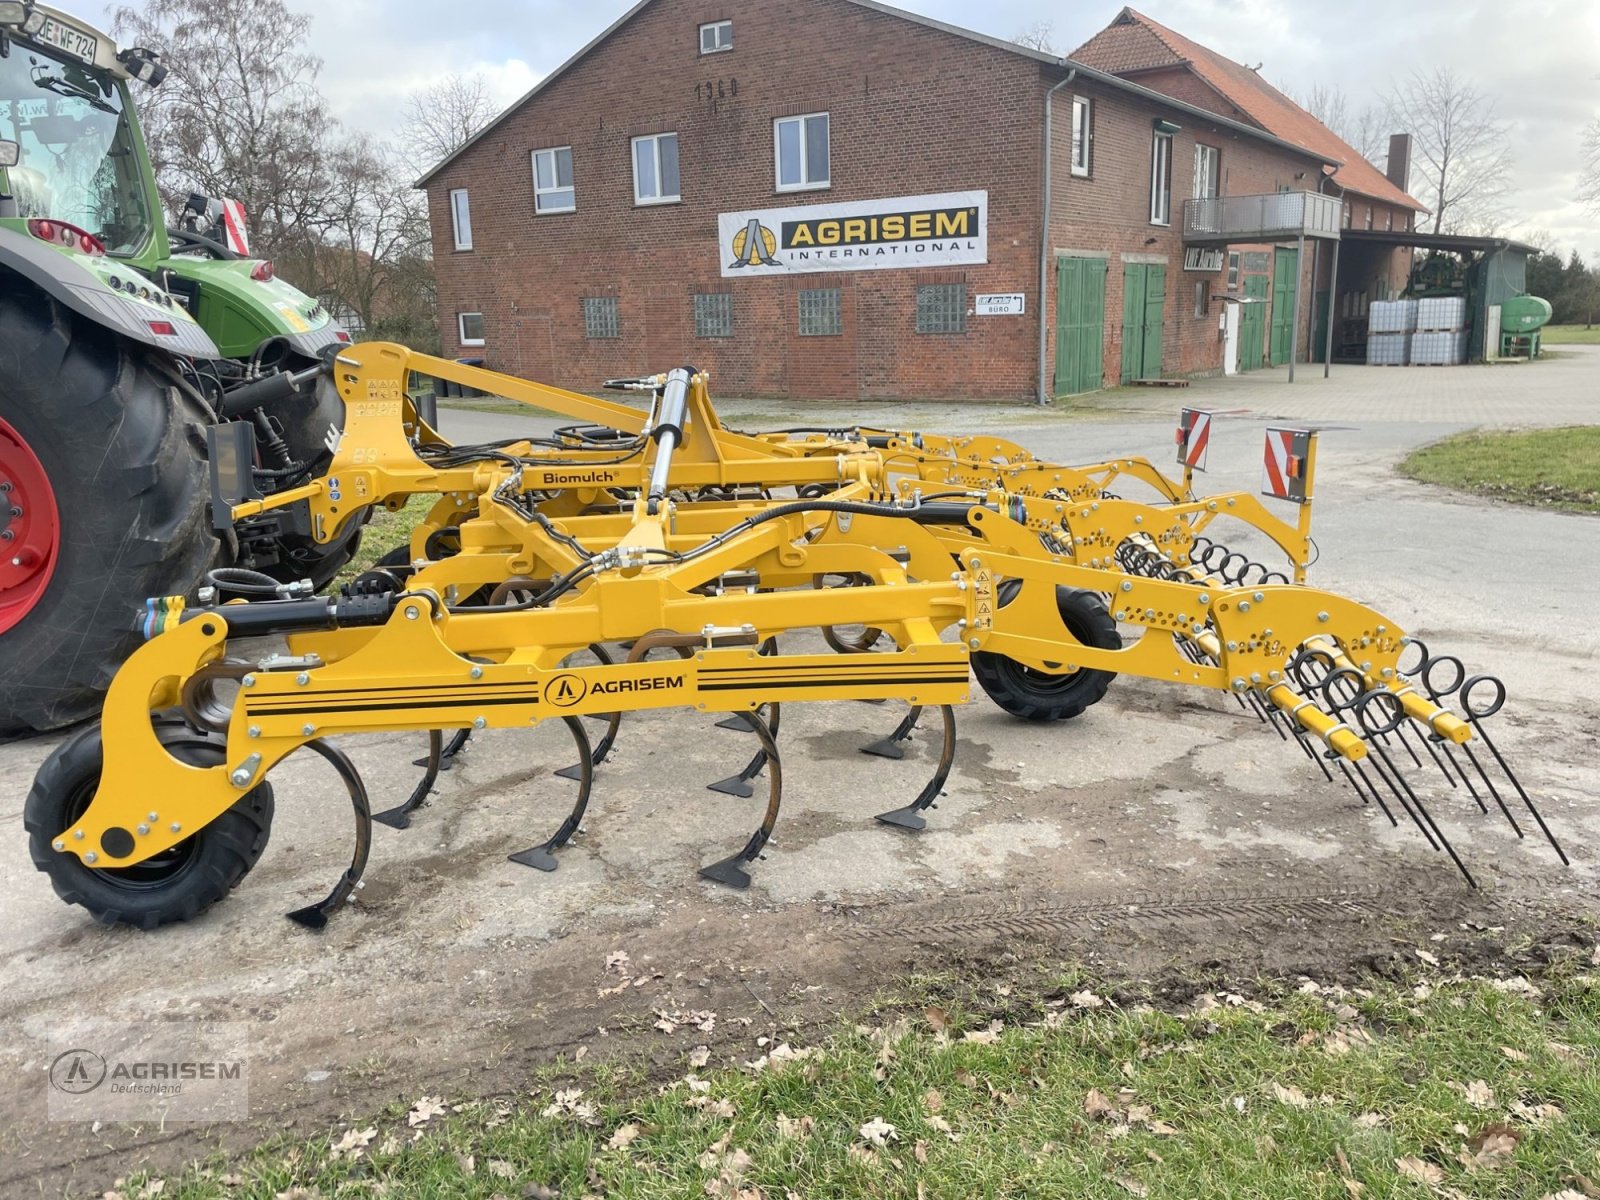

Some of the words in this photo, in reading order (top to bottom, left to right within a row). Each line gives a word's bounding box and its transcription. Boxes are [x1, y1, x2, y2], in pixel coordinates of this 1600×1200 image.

[61, 28, 74, 48] WF
[76, 35, 94, 59] 724
[694, 77, 737, 101] 1960
[790, 241, 975, 260] INTERNATIONAL
[988, 305, 1009, 313] BÜRO
